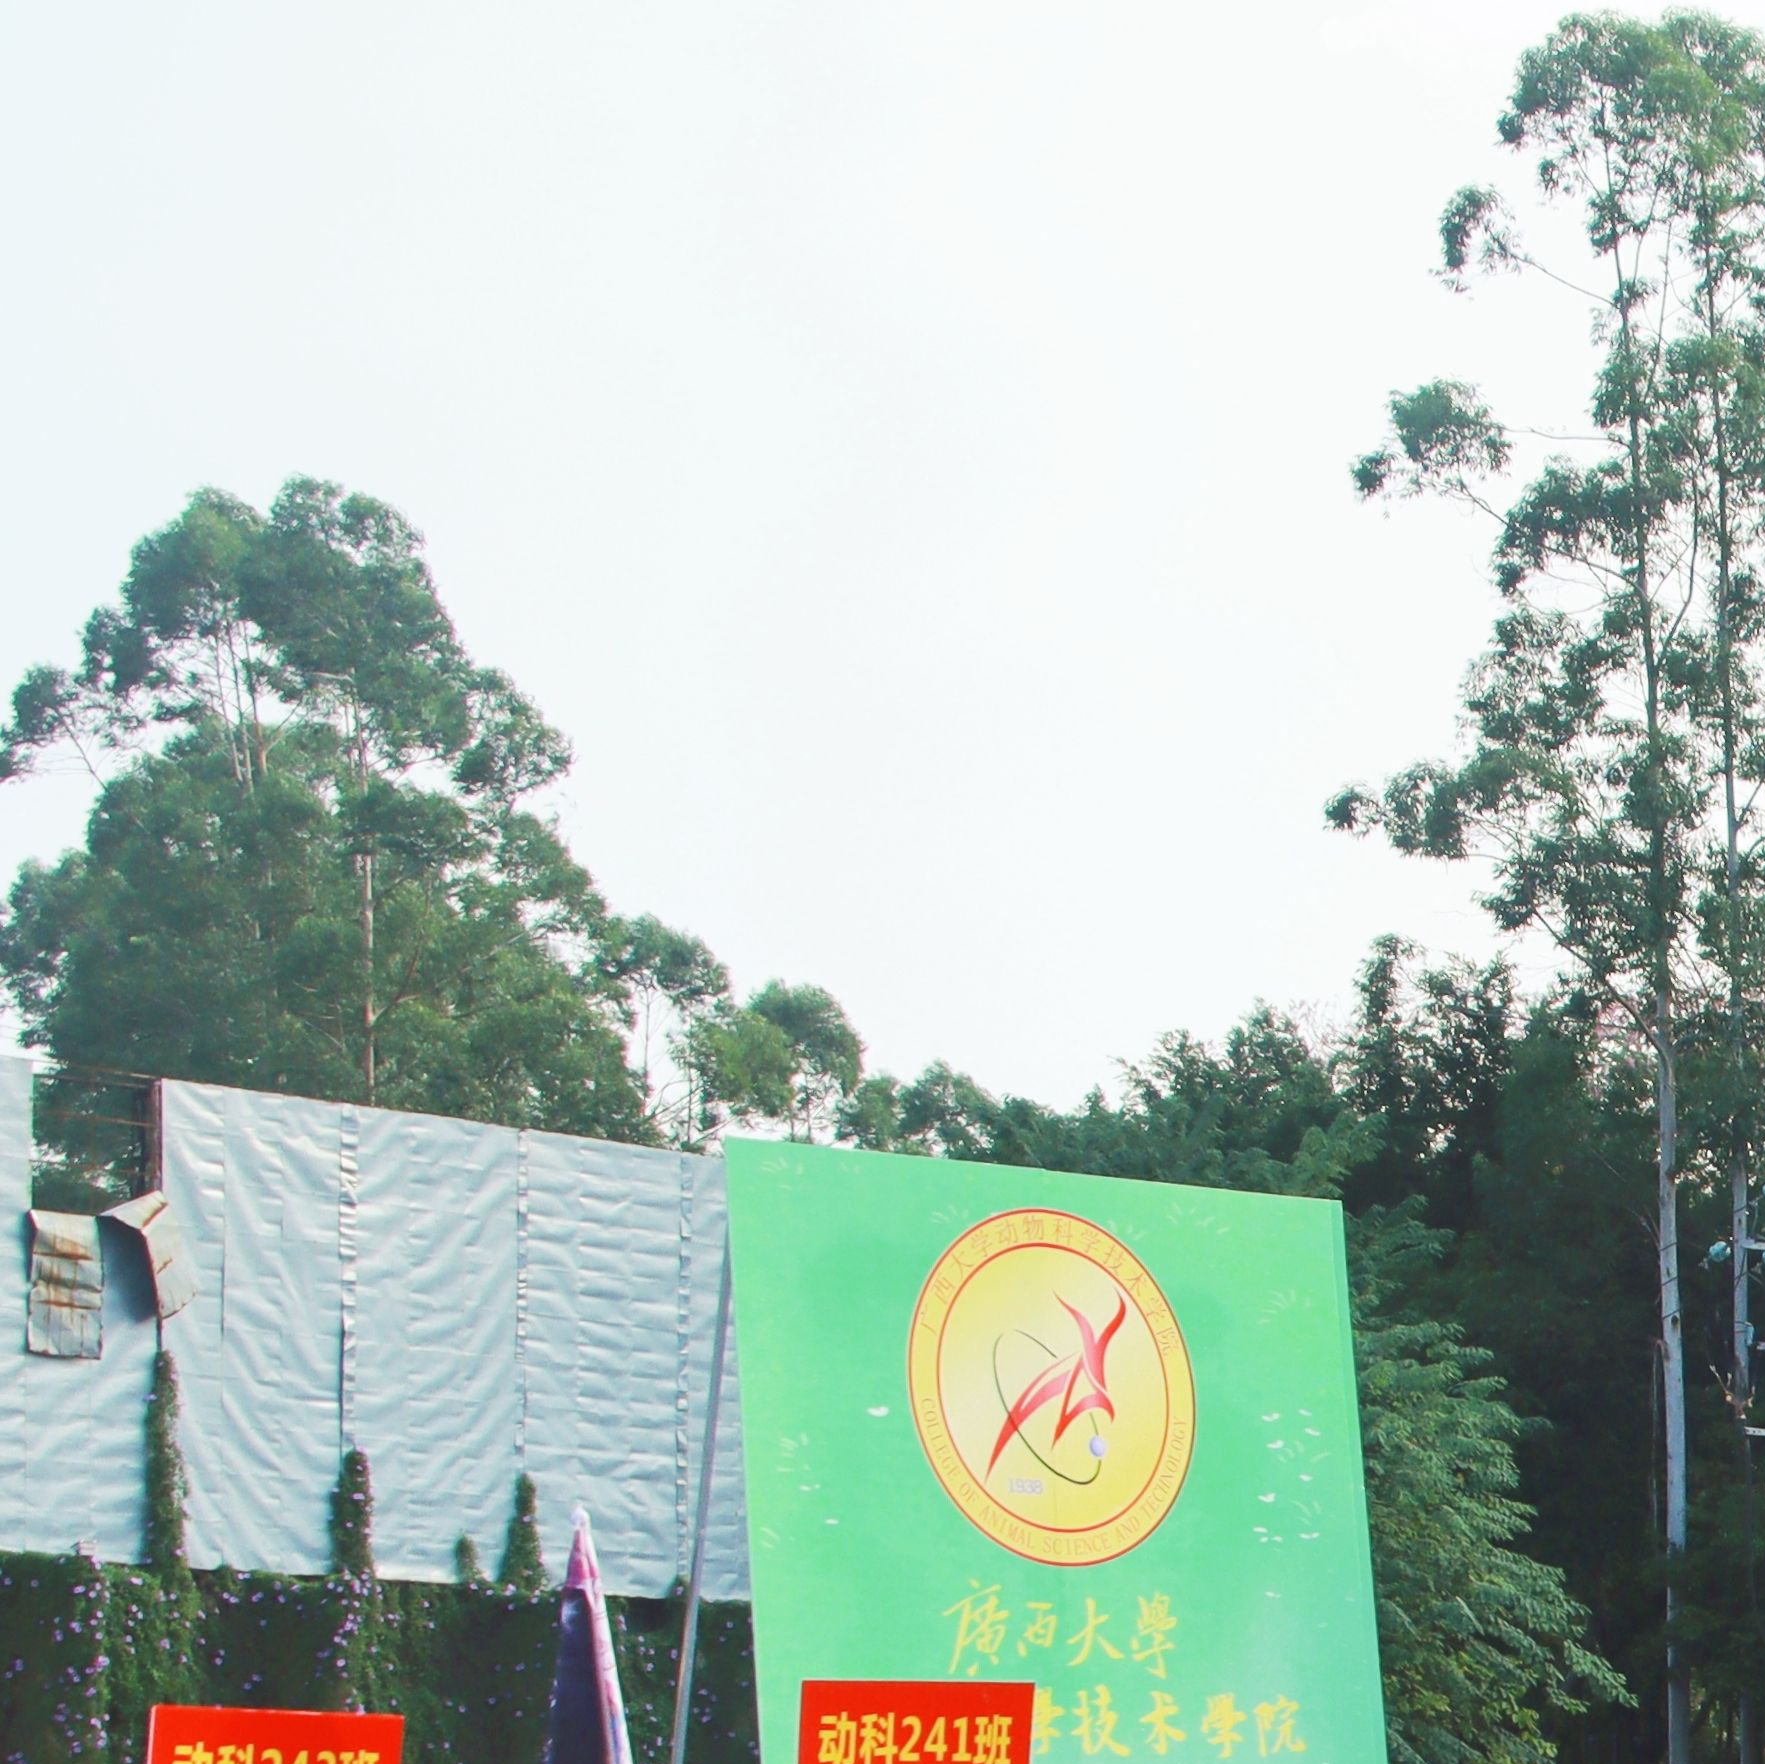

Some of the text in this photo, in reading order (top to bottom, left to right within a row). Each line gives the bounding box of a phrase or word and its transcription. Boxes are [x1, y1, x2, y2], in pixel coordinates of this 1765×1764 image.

[959, 1482, 980, 1503] OF
[979, 1504, 1036, 1549] ANIMAL
[1042, 1533, 1112, 1557] SCIENCE
[1114, 1515, 1142, 1545] AND
